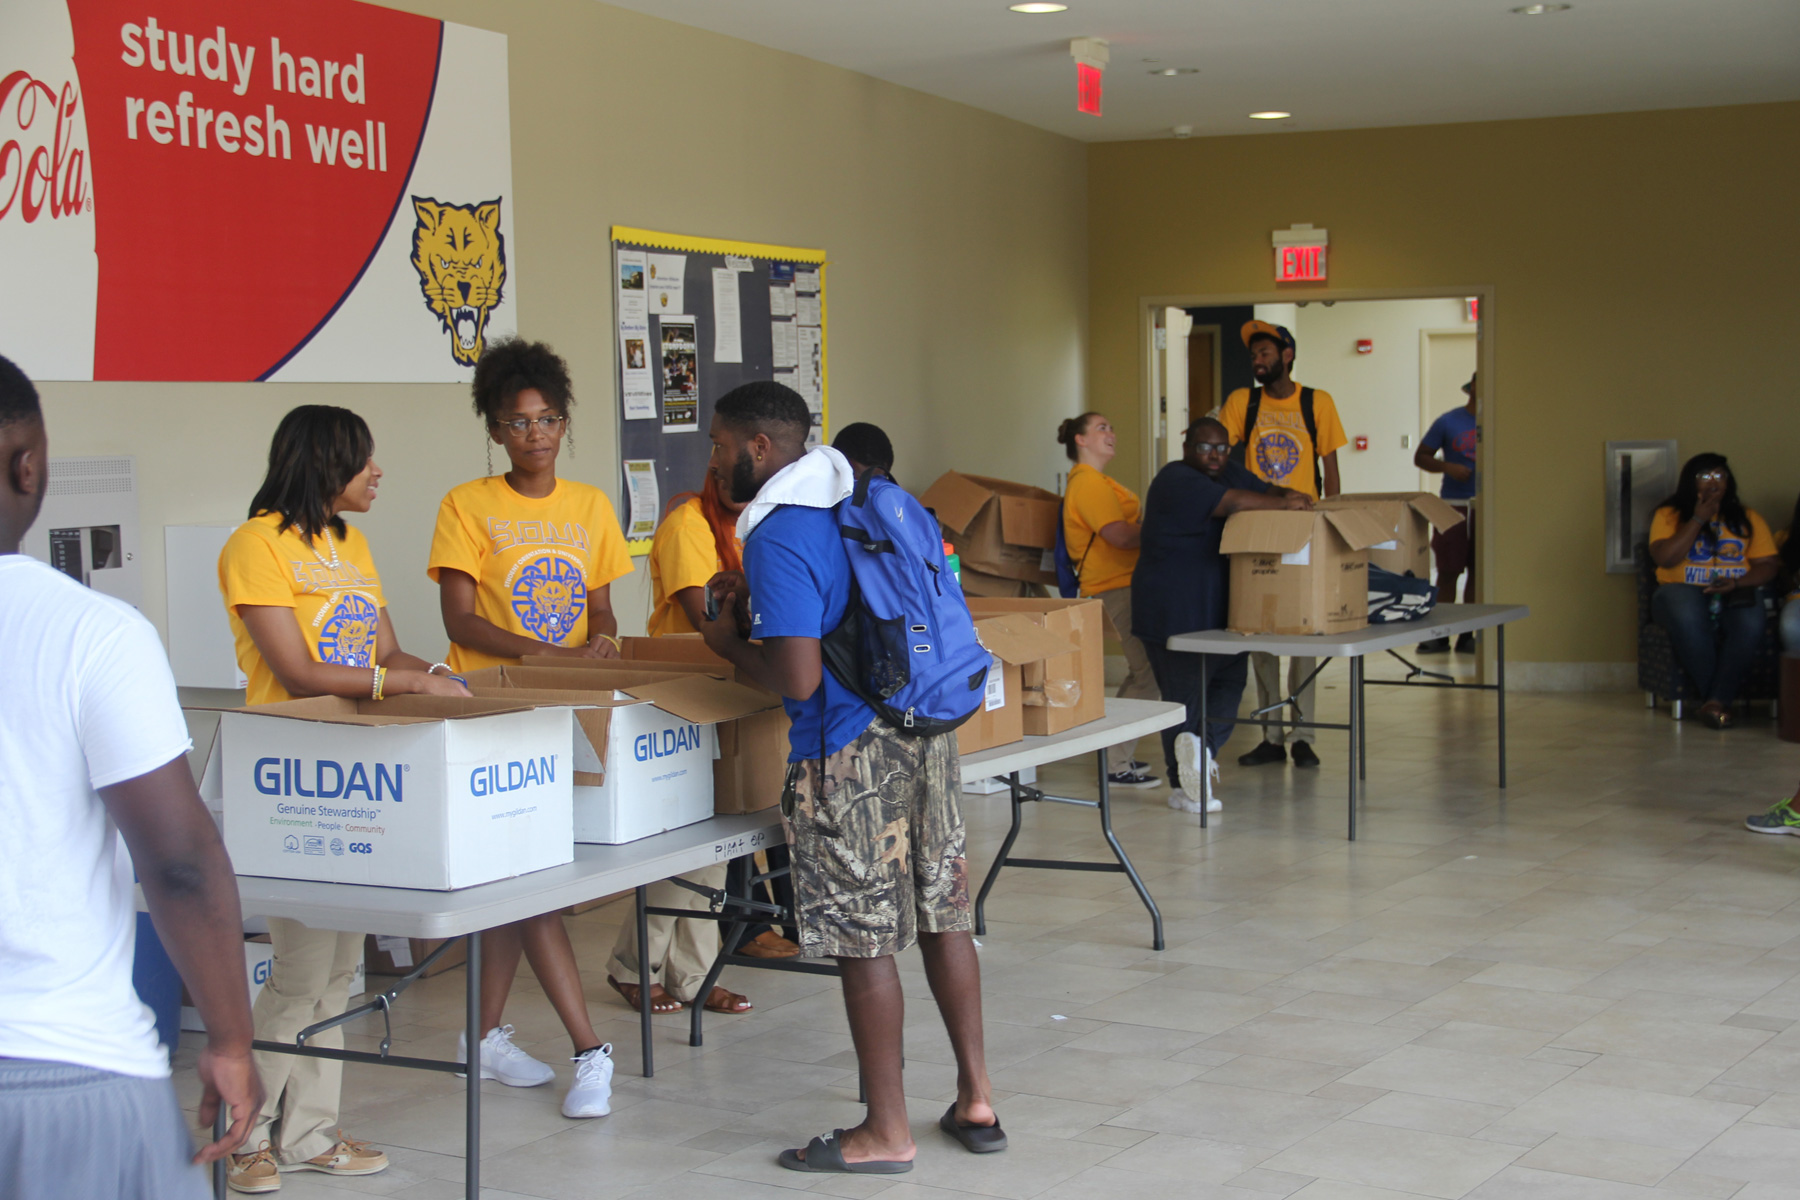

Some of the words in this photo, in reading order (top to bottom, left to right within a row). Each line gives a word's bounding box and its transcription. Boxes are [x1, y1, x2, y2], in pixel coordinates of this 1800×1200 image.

[120, 16, 256, 96] study
[271, 36, 366, 105] hard
[125, 91, 292, 160] refresh
[304, 119, 388, 173] well
[1282, 246, 1322, 278] EXIT
[504, 563, 520, 588] STUDENT
[517, 548, 552, 566] ORIENTATION
[312, 602, 331, 628] STUDENT
[634, 724, 701, 762] GILDAN
[276, 803, 316, 816] Genuine
[491, 806, 538, 820] www.mygildan.com
[269, 817, 313, 828] Environment
[345, 824, 386, 835] Community
[349, 842, 373, 854] GQS
